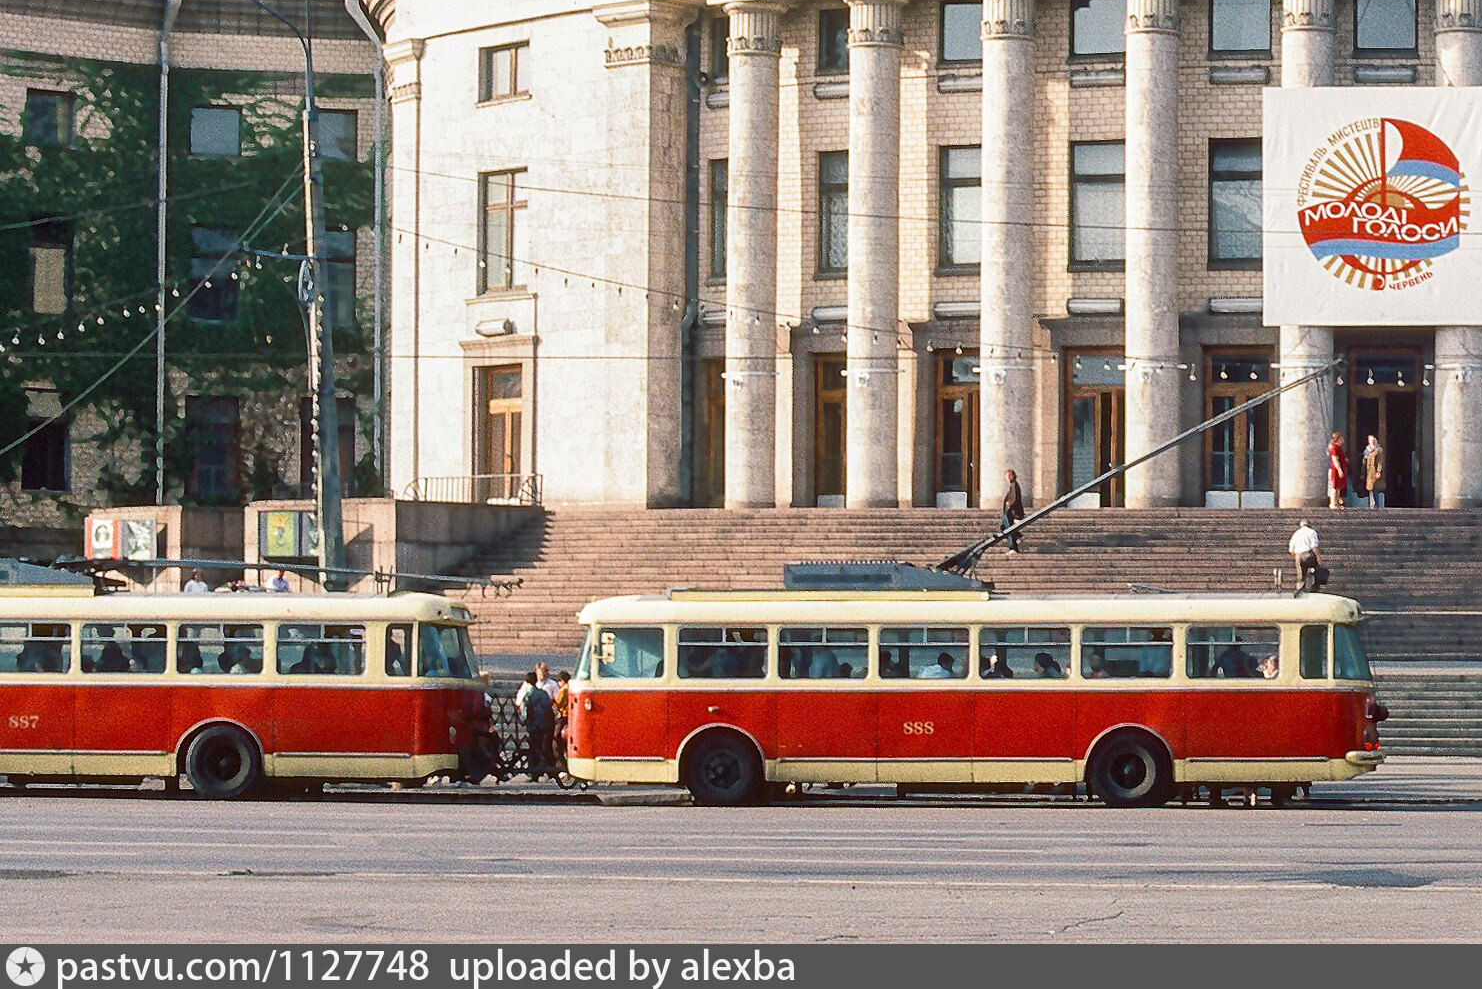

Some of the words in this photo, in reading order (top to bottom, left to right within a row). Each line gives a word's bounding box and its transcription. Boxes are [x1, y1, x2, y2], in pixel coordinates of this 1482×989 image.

[1297, 147, 1327, 206] ФЕСТИВАЛЬ
[1327, 117, 1380, 146] МИСТЕЦТВ
[1304, 201, 1407, 226] МОЛОДІ
[1352, 216, 1459, 242] ГОЛОСИ
[1388, 271, 1434, 291] ЧЕРВЕНЬ
[8, 714, 40, 729] 887
[903, 721, 934, 735] 888
